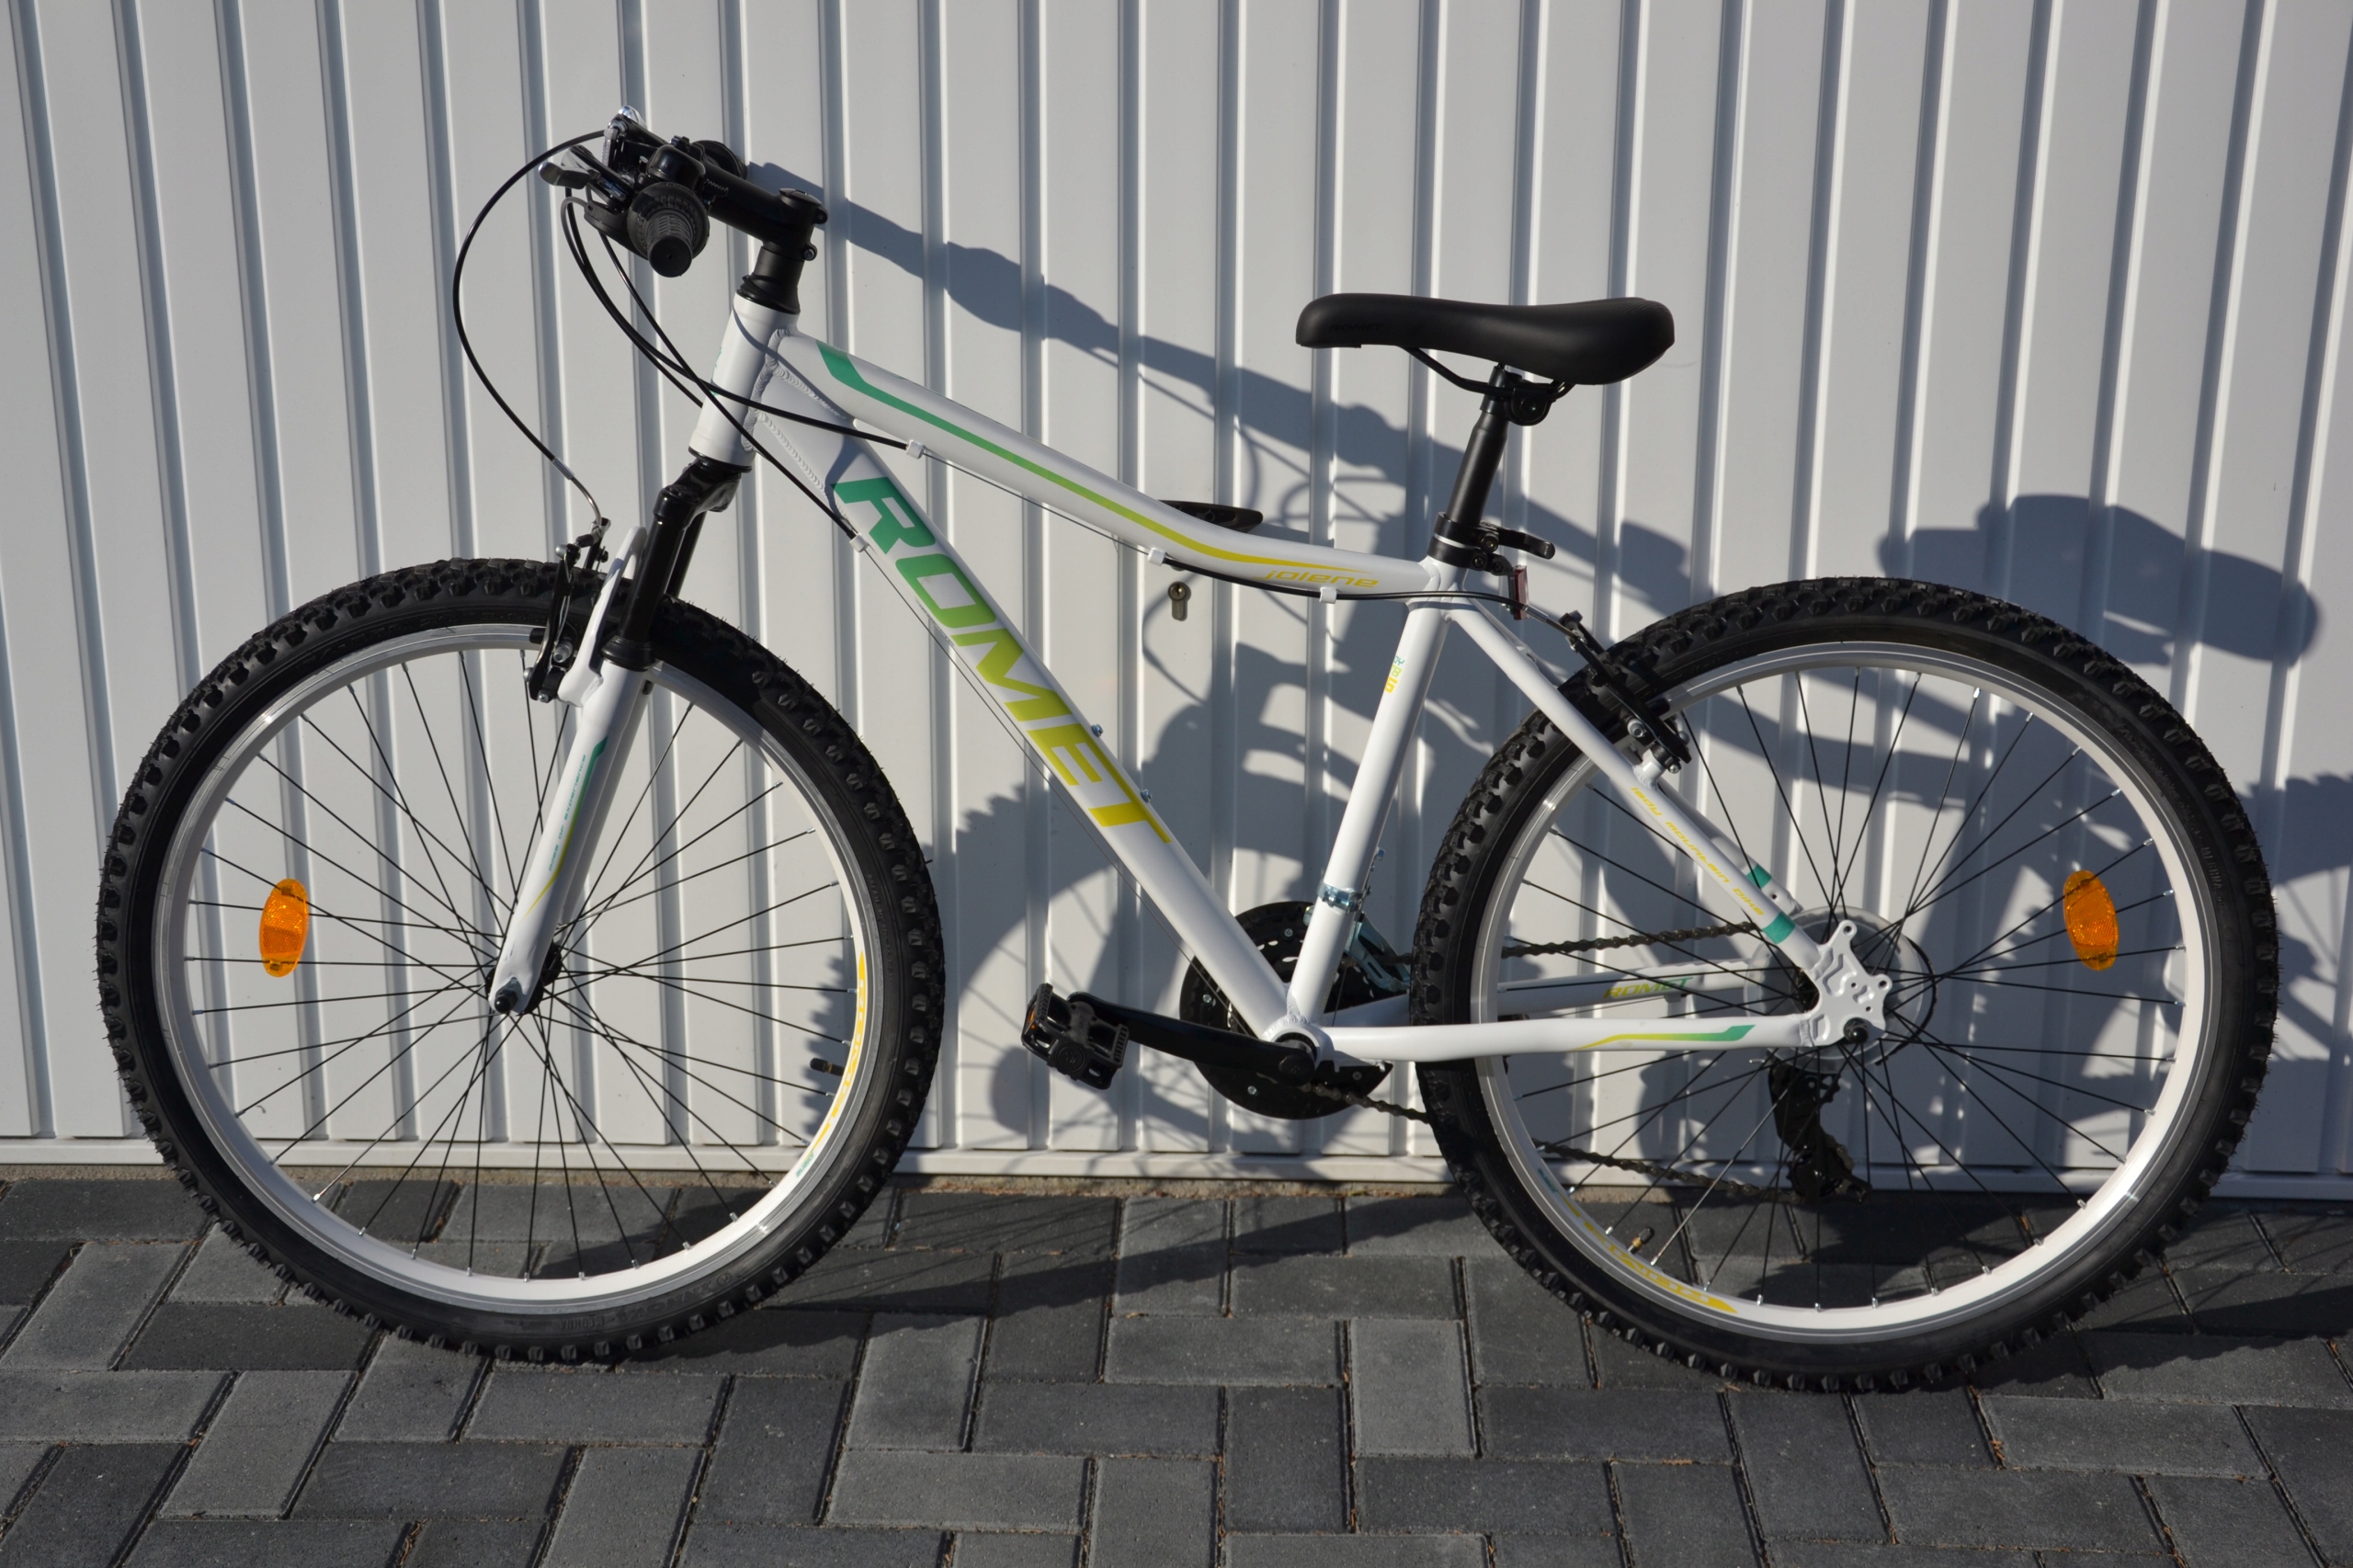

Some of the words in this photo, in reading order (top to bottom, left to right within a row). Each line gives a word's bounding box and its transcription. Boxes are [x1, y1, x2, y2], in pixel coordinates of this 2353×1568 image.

[1330, 323, 1384, 332] ROMET
[1253, 570, 1379, 588] jolene
[830, 476, 1172, 844] ROMET
[1631, 787, 1663, 816] lady
[1665, 821, 1730, 883] mountain
[1733, 888, 1765, 915] bike
[1603, 977, 1694, 999] ROMET
